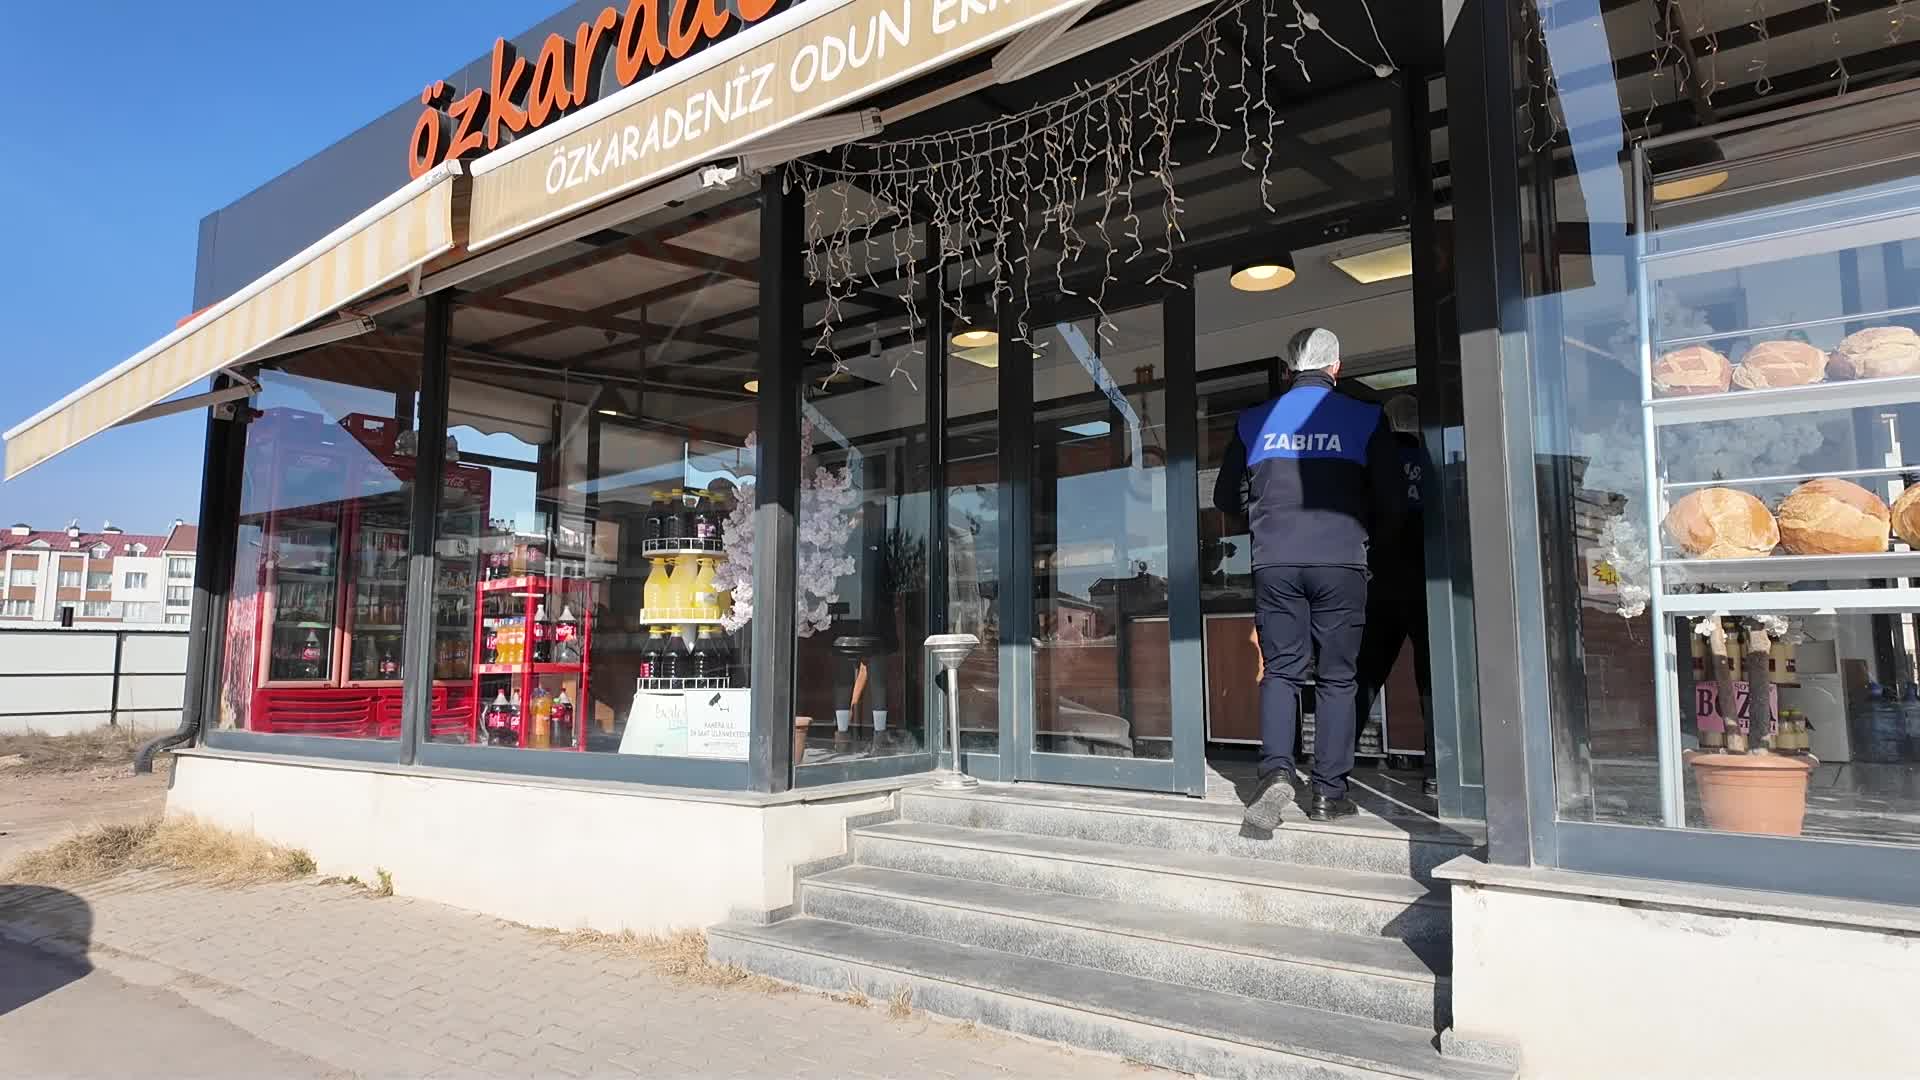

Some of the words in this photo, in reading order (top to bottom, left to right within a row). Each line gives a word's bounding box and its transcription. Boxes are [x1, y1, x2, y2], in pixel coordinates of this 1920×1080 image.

[408, 0, 779, 180] özkarad
[545, 62, 775, 195] ÖZKARADENİZ
[790, 0, 911, 93] ODUN
[1263, 432, 1342, 452] ZABITA
[1696, 688, 1777, 722] BZ
